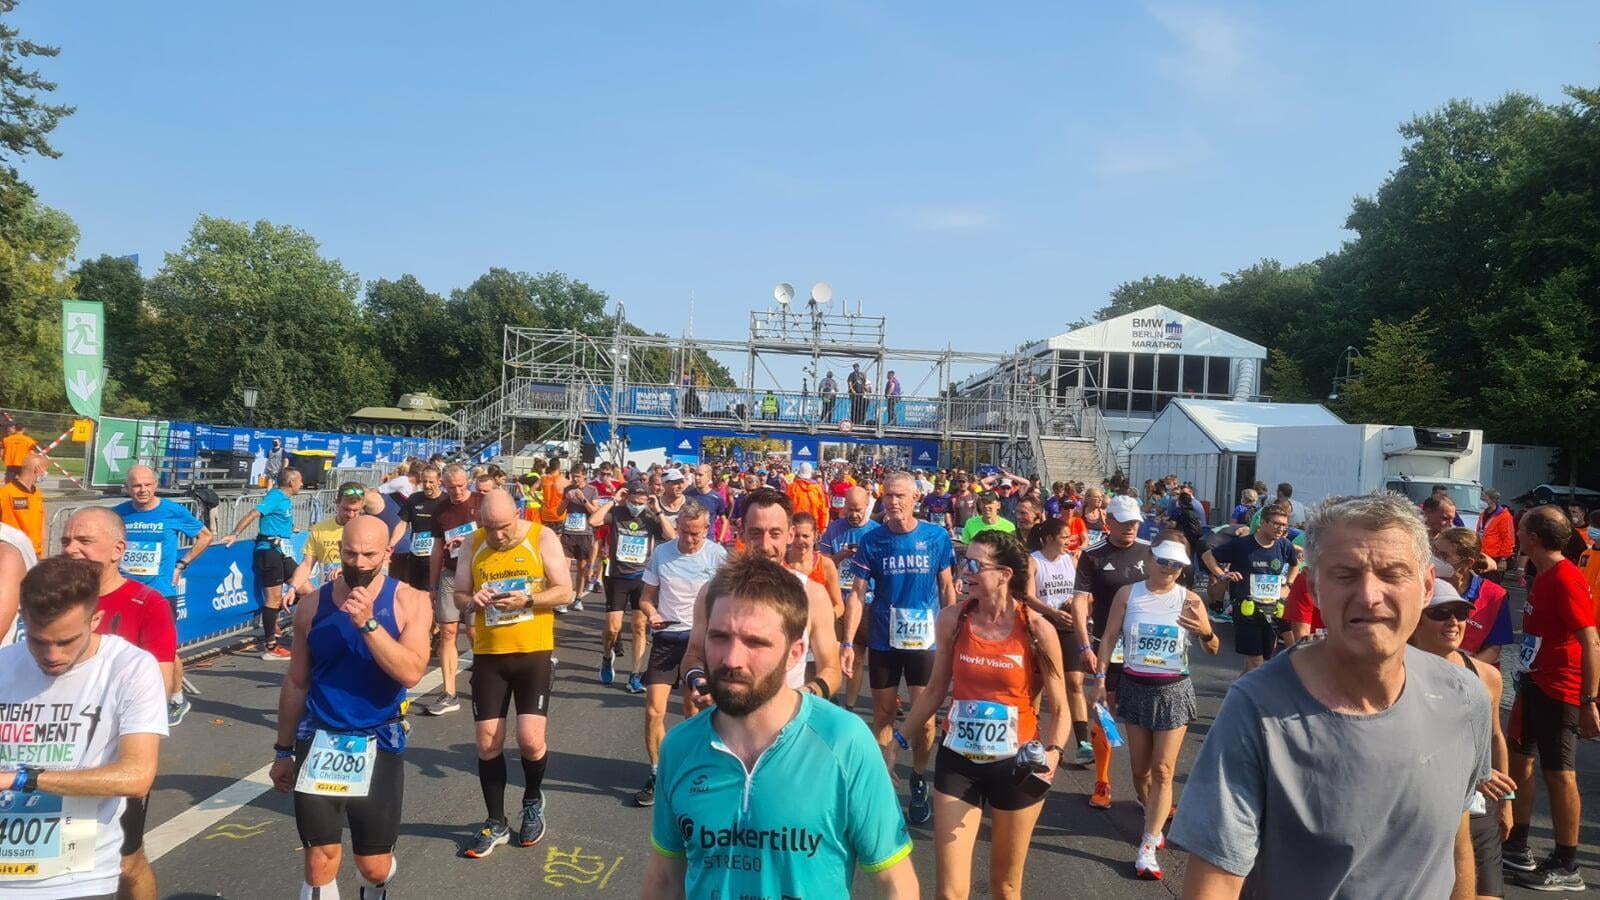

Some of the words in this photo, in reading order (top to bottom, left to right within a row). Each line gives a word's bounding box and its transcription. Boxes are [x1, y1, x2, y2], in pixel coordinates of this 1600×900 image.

[1132, 318, 1164, 328] BMW
[1132, 330, 1164, 339] BERLIN
[1132, 341, 1183, 349] MARATHON
[122, 551, 156, 563] 58963
[882, 554, 930, 570] FRANCE
[1044, 580, 1074, 589] HUMAN
[1051, 573, 1065, 581] NO
[212, 590, 249, 611] adidas
[1039, 589, 1048, 597] IS
[896, 621, 928, 635] 21411
[1138, 636, 1177, 654] 56918
[959, 652, 985, 666] World
[986, 657, 1014, 670] Vision
[0, 703, 45, 722] RIGHT
[50, 703, 74, 722] TO
[958, 720, 1007, 742] 55702
[312, 751, 366, 774] 12080
[319, 771, 350, 781] Christian
[701, 822, 824, 858] bakertilly
[703, 854, 762, 873] STREGO
